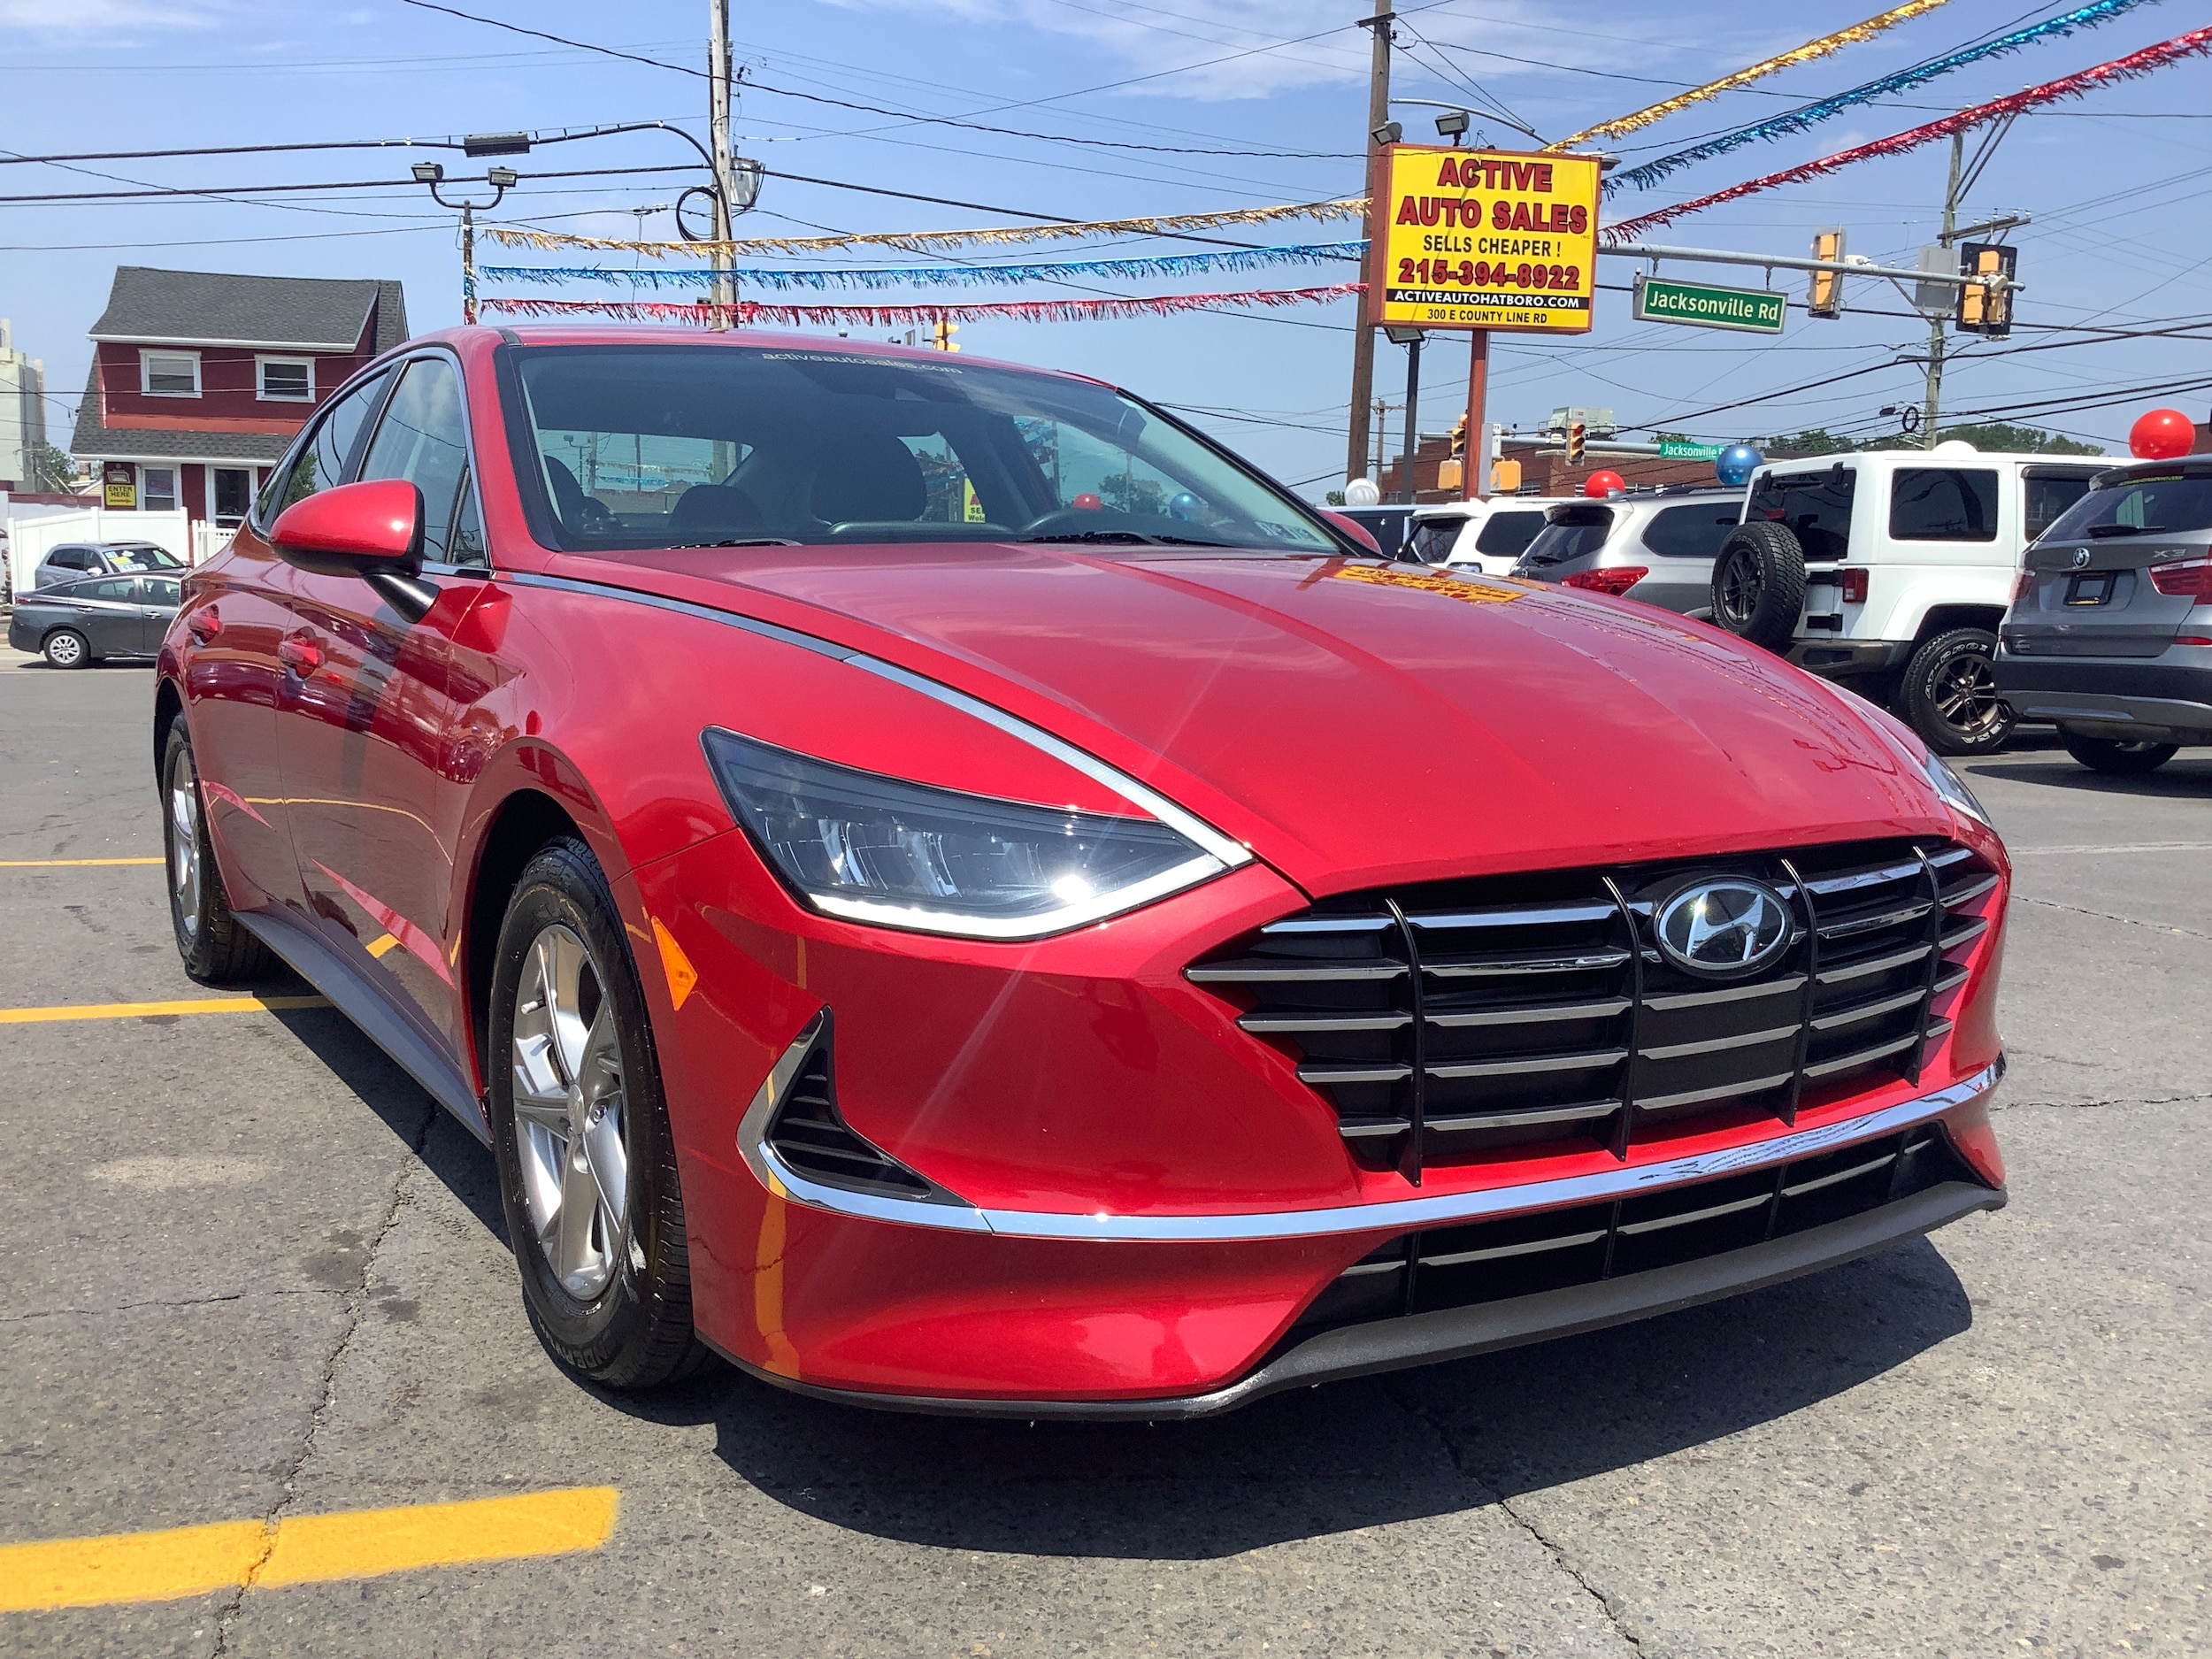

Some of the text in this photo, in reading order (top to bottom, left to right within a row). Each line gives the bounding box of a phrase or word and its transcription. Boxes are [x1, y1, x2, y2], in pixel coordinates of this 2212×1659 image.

[1437, 157, 1553, 193] ACTIVE
[1396, 196, 1588, 234] AUTO SALES
[1423, 234, 1472, 253] SELLS
[1478, 238, 1551, 257] CHEAPER
[1398, 257, 1579, 290] 215-394-8922
[1394, 290, 1579, 309] ACTIVEAUTOHATBORO.COM
[1649, 290, 1779, 321] Jacksonville Rd
[1427, 309, 1548, 324] 300 E COUNTY LINE RD
[761, 352, 964, 374] activeautosales.com
[1663, 444, 1717, 458] Jacksonville
[2151, 549, 2187, 558] X3
